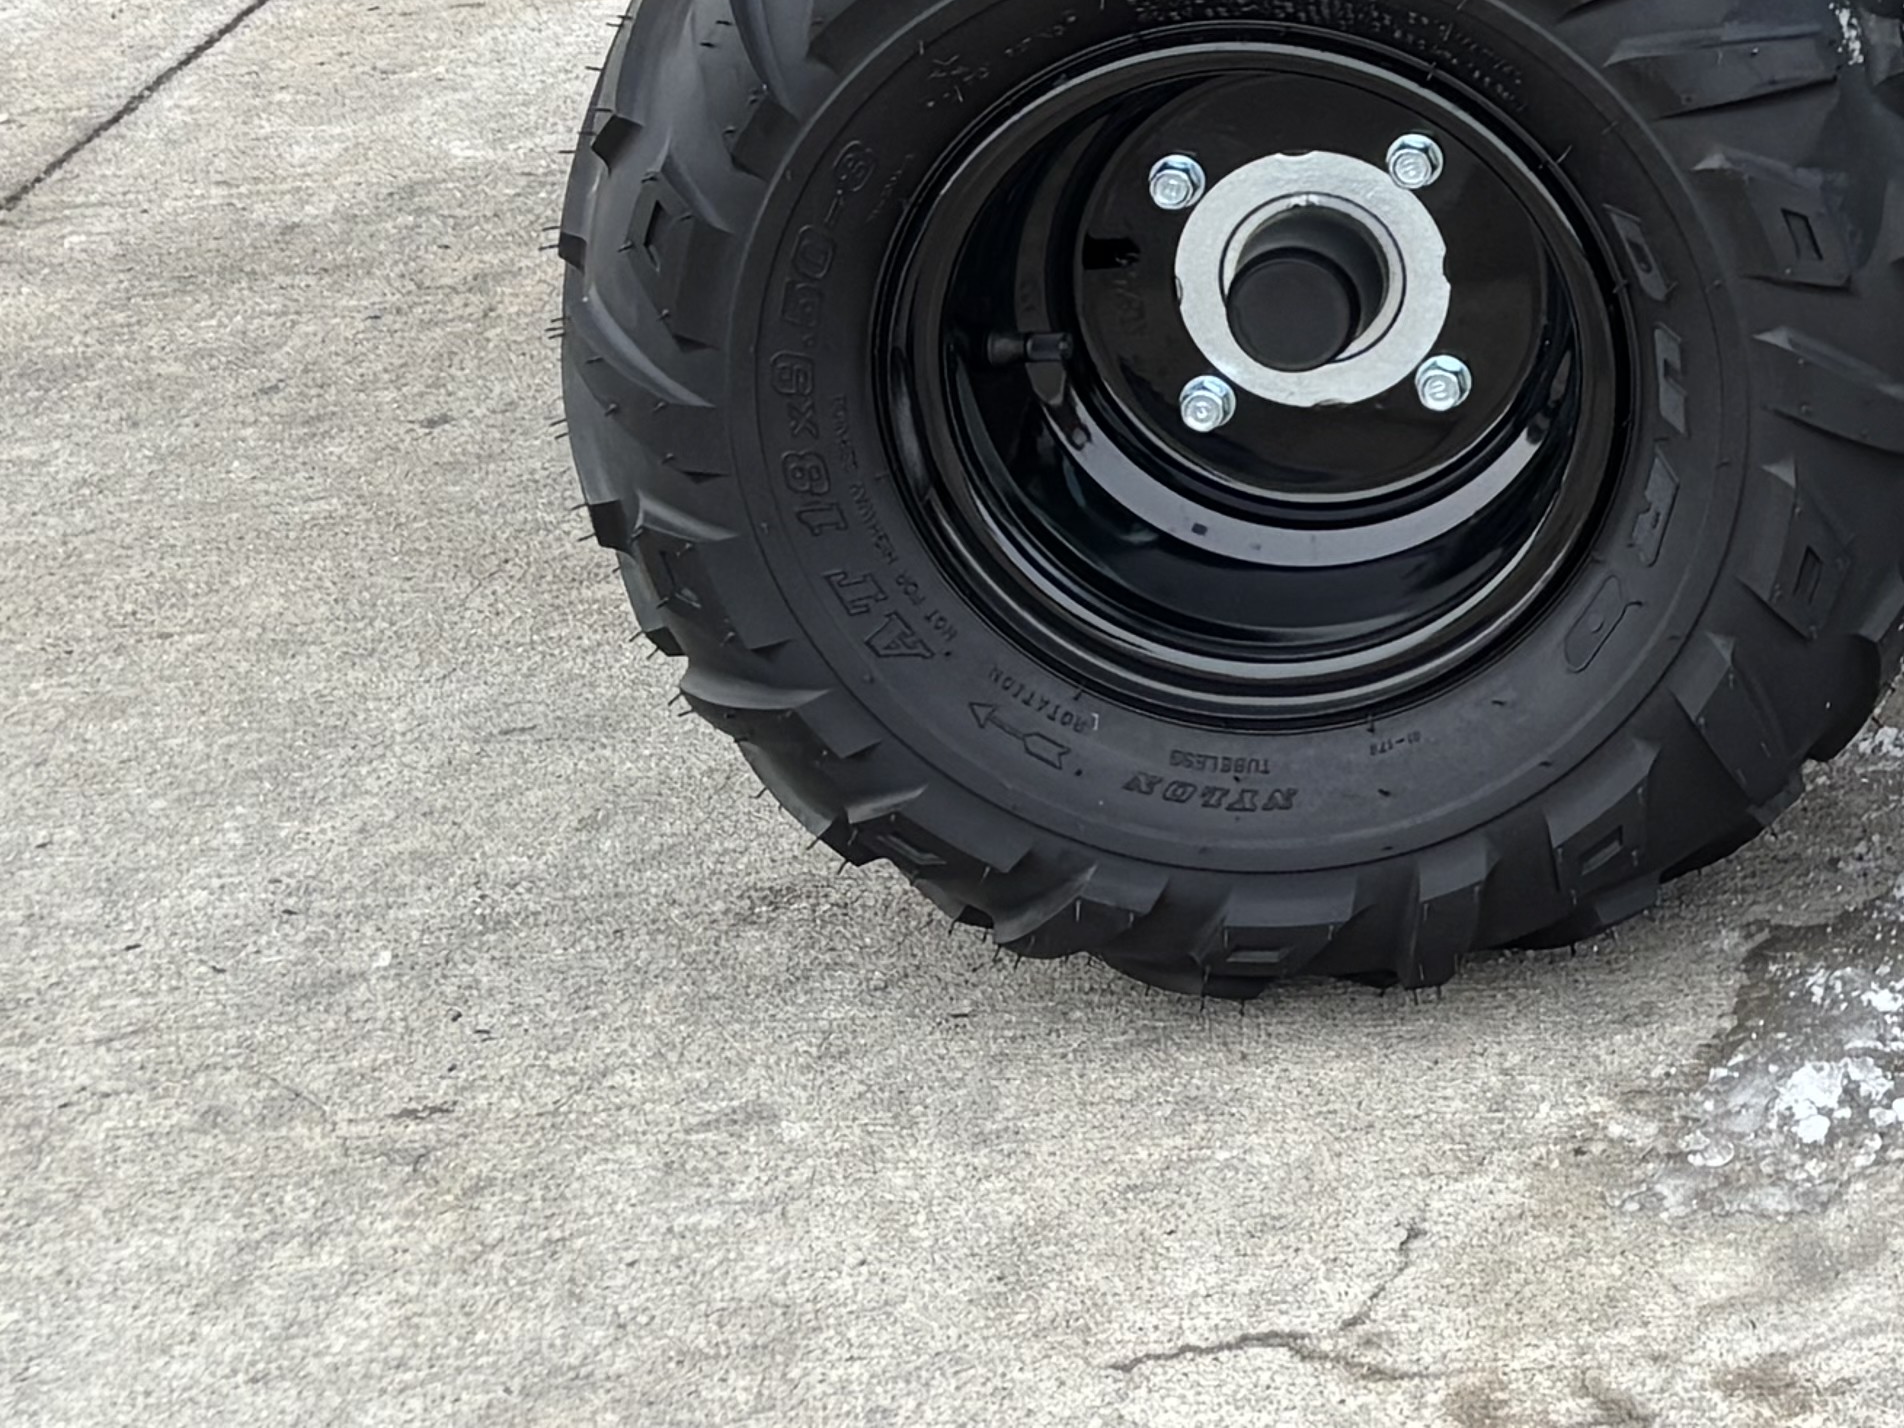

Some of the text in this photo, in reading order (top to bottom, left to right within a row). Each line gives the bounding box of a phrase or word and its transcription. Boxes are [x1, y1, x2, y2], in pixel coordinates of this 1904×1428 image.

[769, 139, 937, 661] AT 18x9.50-8
[1561, 201, 1687, 674] DURO
[849, 478, 903, 569] HIGHWAY
[891, 566, 930, 610] FOR
[921, 604, 962, 646] NOT
[985, 665, 1088, 735] ROTATION
[1167, 748, 1270, 775] TUBELESS
[1123, 770, 1299, 812] NYLON
